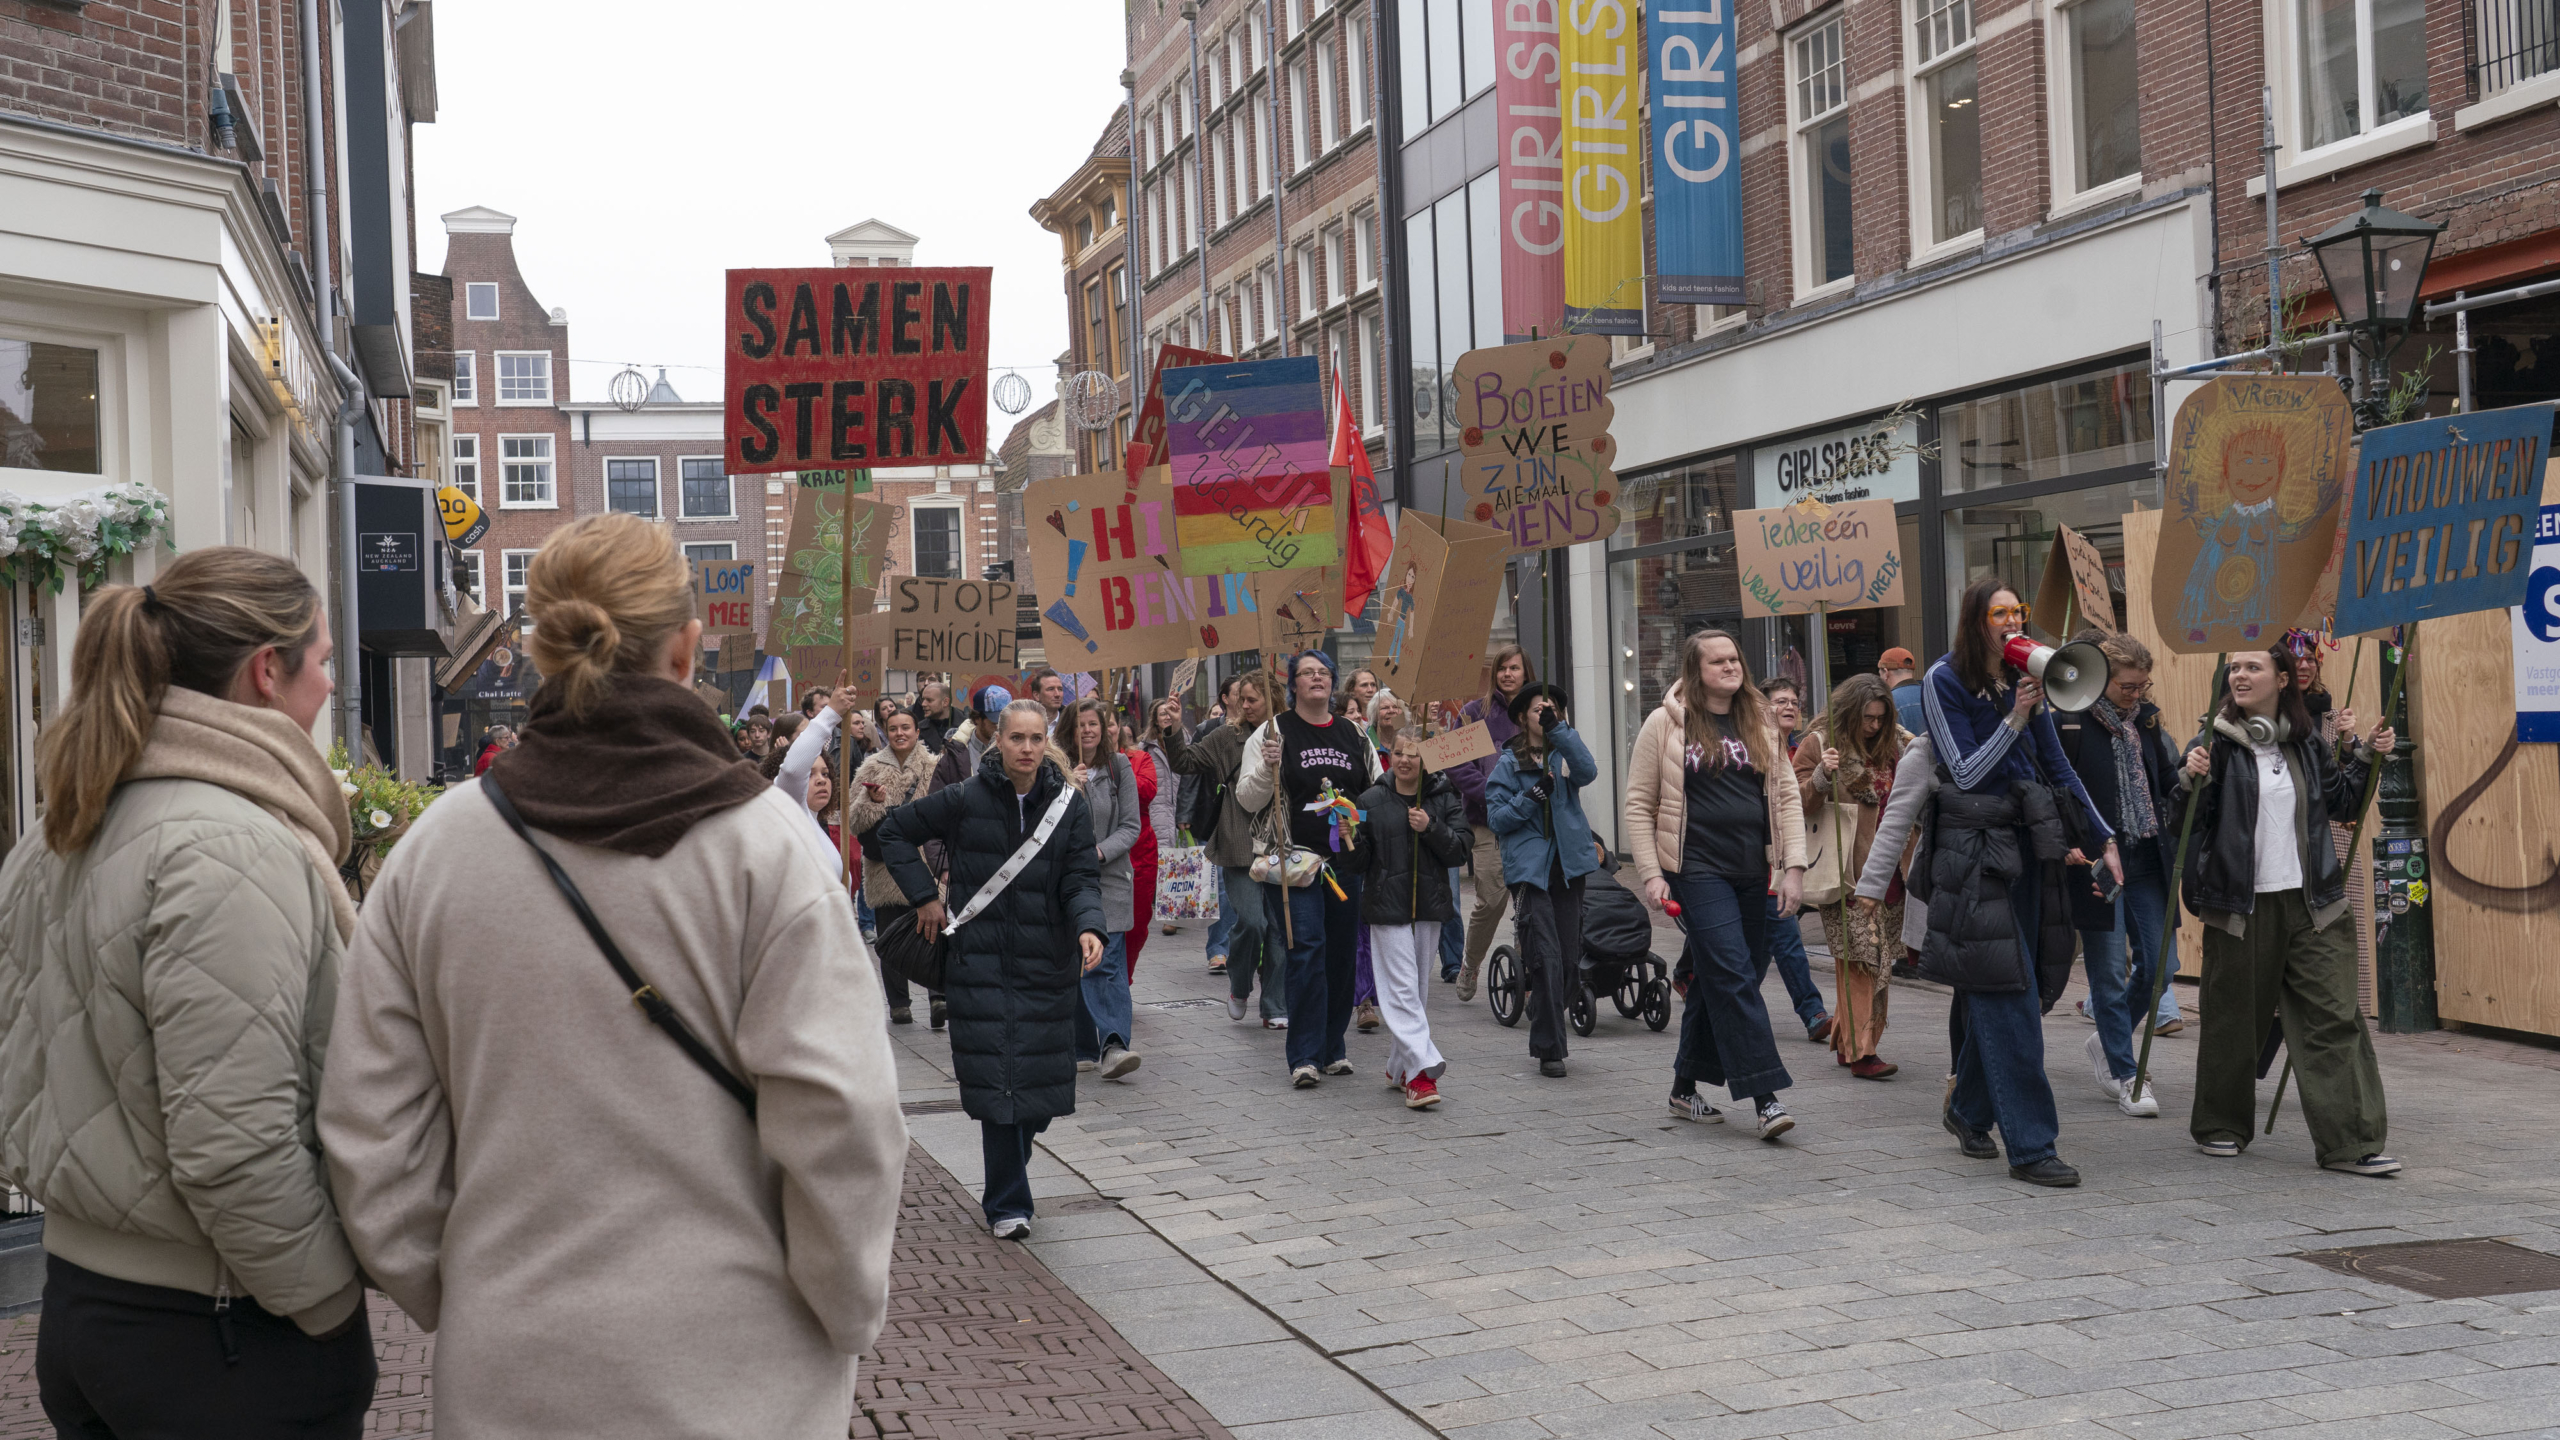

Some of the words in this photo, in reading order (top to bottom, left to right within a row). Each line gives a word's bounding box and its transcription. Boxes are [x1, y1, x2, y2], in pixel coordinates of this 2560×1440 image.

[1658, 0, 1730, 183] GIRL
[1569, 0, 1630, 223] GIRLS
[1662, 283, 1676, 292] kids
[1679, 283, 1694, 292] and
[1693, 284, 1713, 293] teens
[1714, 284, 1740, 294] fashion
[741, 280, 970, 360] SAMEN
[1595, 317, 1612, 325] teens
[1614, 316, 1639, 325] fashion
[2232, 382, 2313, 409] VROUW
[740, 377, 970, 465] STERK
[1501, 423, 1570, 457] WE
[1824, 491, 1843, 503] teens
[1844, 486, 1870, 500] fashion
[2367, 436, 2538, 520] VROUWEN
[465, 524, 485, 544] cash
[1491, 488, 1600, 548] MENS
[2355, 513, 2524, 598] VEILIG
[705, 564, 753, 595] LOOP
[1866, 550, 1901, 603] VREDE
[708, 601, 750, 628] MEE
[900, 579, 1011, 616] STOP
[1300, 748, 1348, 760] PERFECT
[1301, 757, 1352, 770] GODDESS
